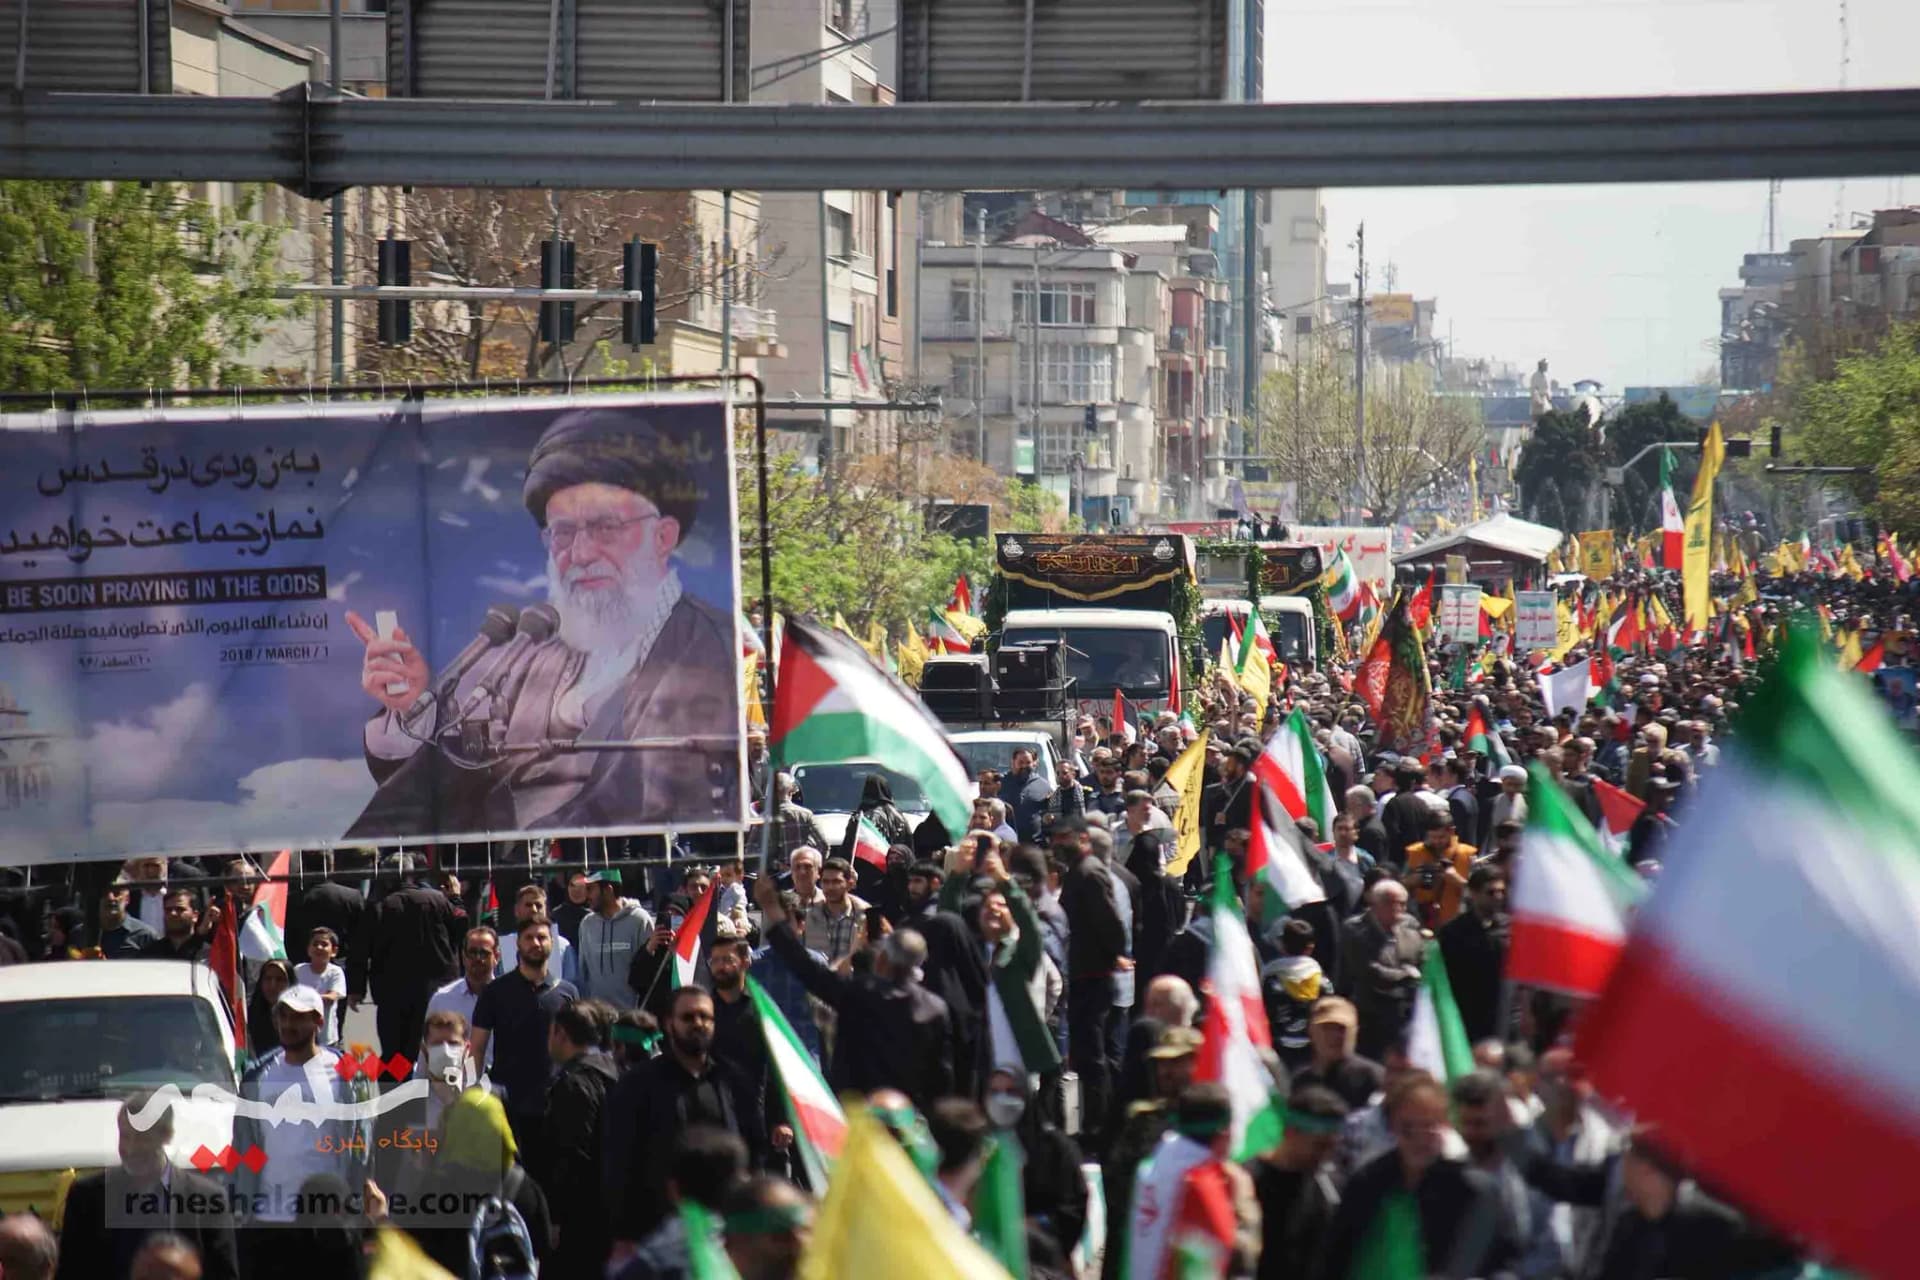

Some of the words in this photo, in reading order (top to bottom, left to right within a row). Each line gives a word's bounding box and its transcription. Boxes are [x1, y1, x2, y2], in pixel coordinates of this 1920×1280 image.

[36, 445, 159, 497] قدس
[145, 455, 188, 495] در
[190, 446, 280, 490] زودی
[281, 448, 320, 487] به
[129, 512, 261, 556] جماعت
[248, 506, 324, 557] نماز
[7, 586, 33, 607] BE
[39, 582, 96, 607] SOON
[102, 578, 189, 603] PRAYING
[195, 576, 216, 600] IN
[221, 575, 261, 598] THE
[267, 573, 320, 596] QODS
[0, 626, 49, 645] الجماع
[220, 648, 253, 662] 2018
[265, 646, 310, 660] MARCH
